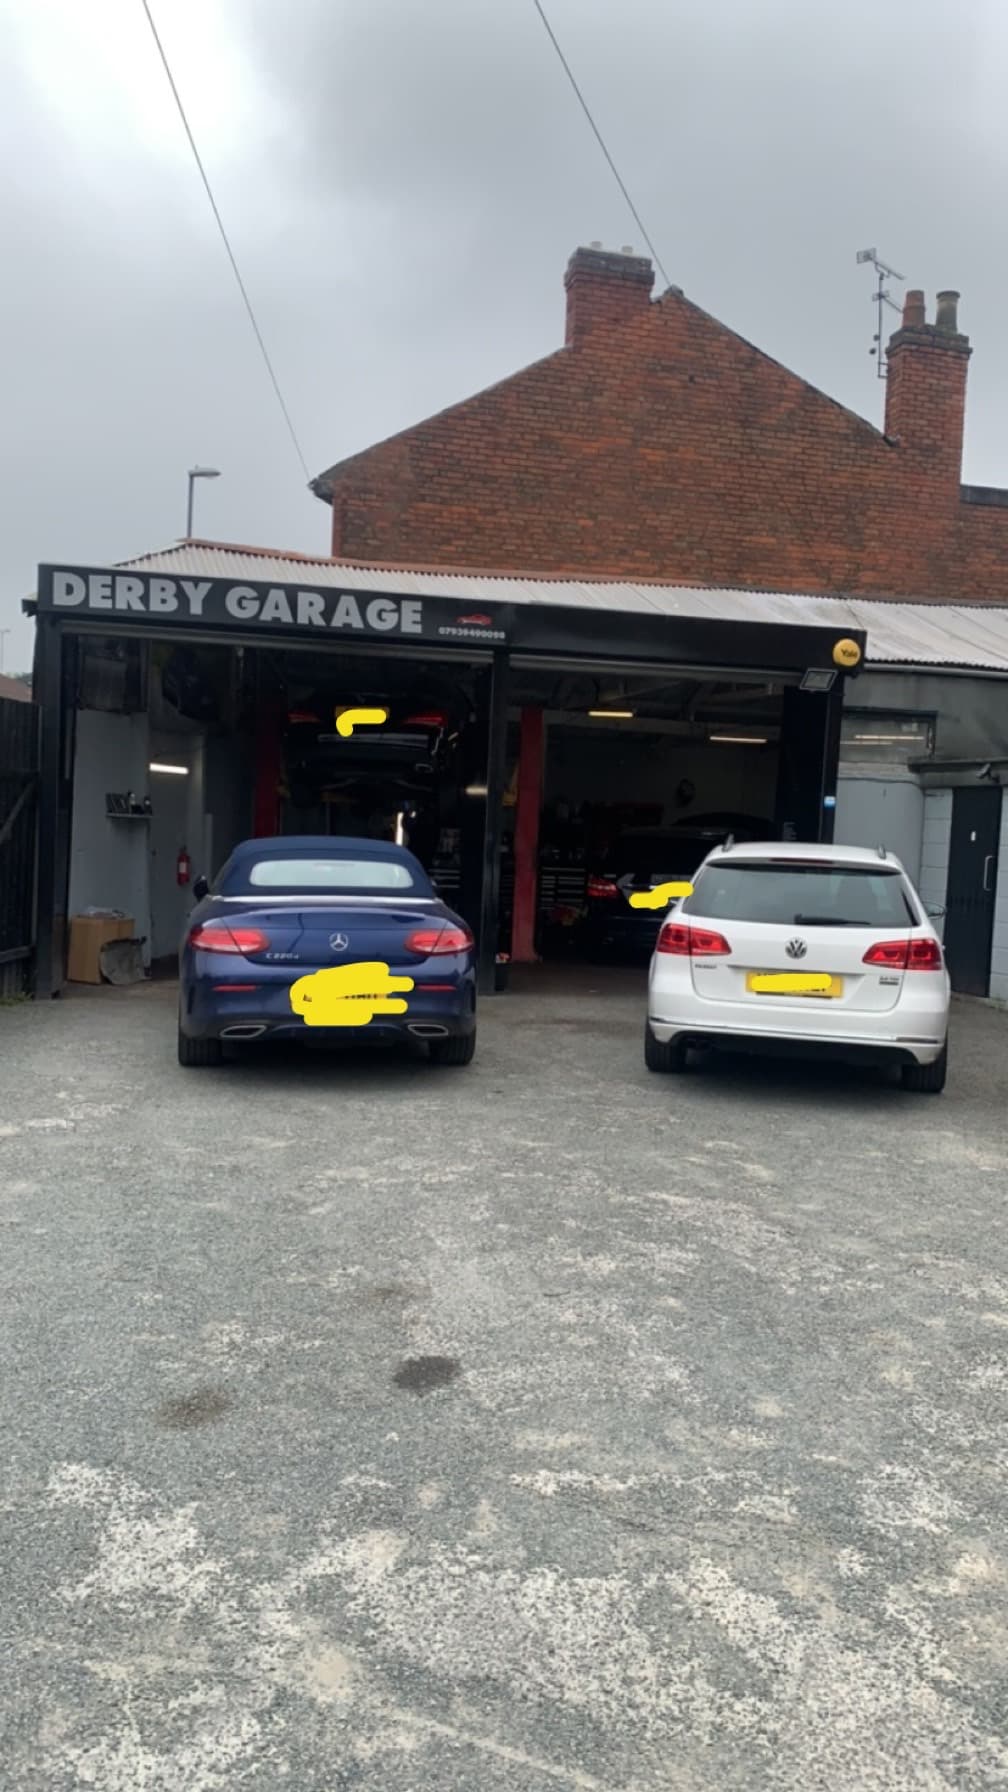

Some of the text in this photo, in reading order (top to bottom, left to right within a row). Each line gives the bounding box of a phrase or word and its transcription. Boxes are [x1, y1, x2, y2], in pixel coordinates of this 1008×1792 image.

[52, 571, 423, 634] DERBY GARAGE
[840, 649, 858, 658] Yale
